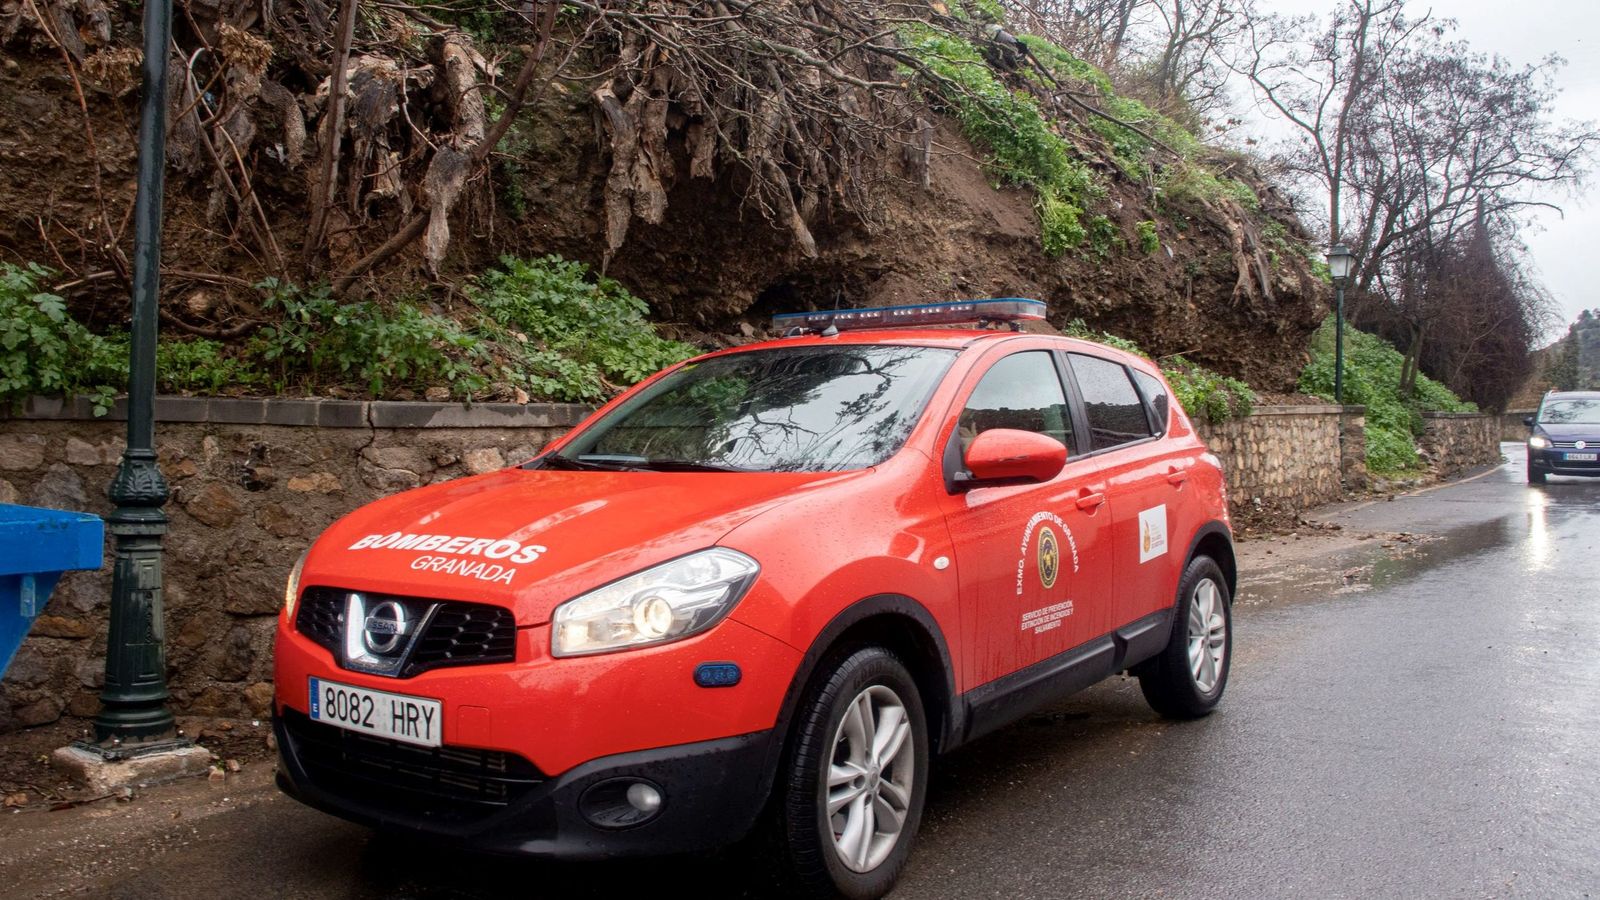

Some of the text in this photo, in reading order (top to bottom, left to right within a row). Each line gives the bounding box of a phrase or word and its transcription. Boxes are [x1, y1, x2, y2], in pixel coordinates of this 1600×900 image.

[348, 532, 547, 563] BOMBEROS
[1021, 511, 1053, 555] AYUNTAMIENTO
[1053, 515, 1063, 527] DE
[1062, 524, 1079, 573] GRANADA
[411, 556, 517, 585] GRANADA
[325, 687, 435, 740] 8082 HRY
